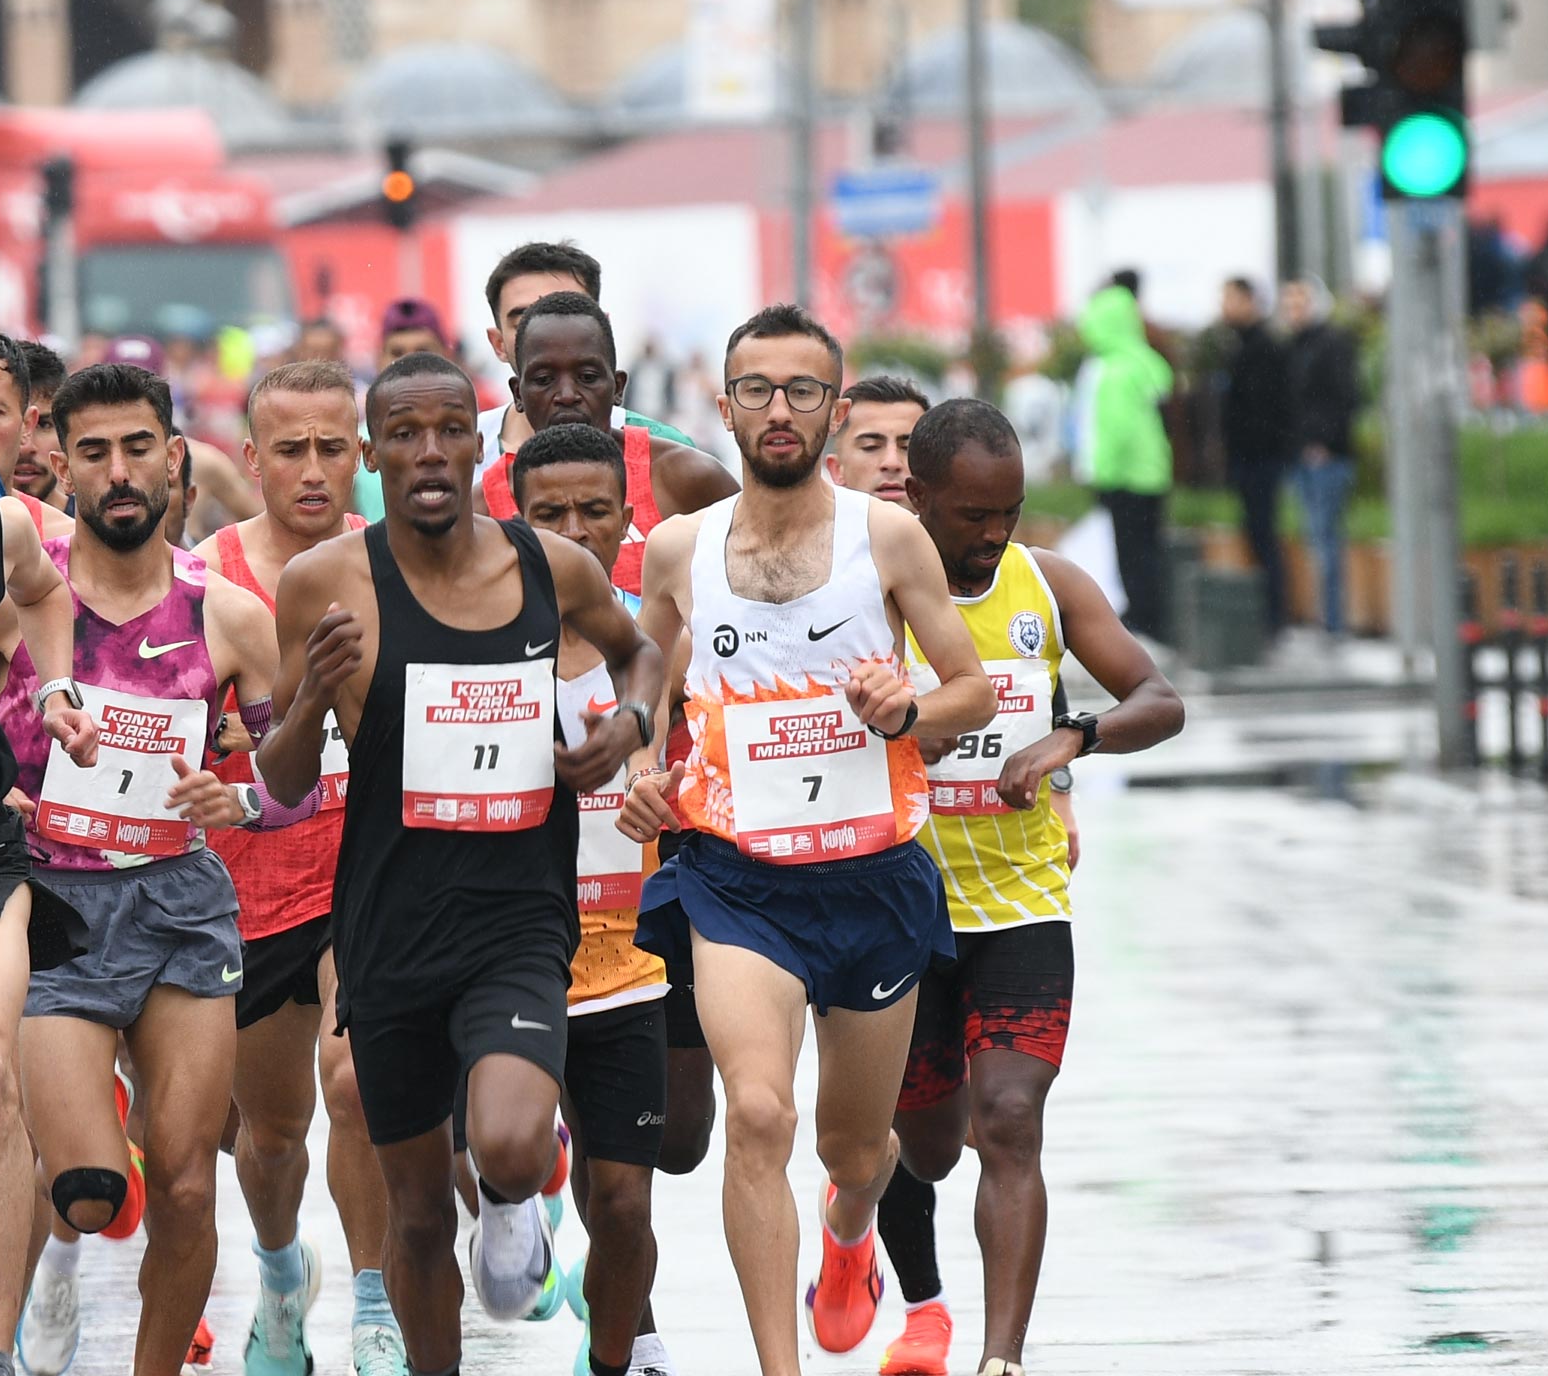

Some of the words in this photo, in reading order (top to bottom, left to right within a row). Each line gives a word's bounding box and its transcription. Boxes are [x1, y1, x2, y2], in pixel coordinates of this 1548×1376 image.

[745, 630, 768, 643] NN
[457, 681, 518, 697] KONYA
[467, 696, 509, 709] YARI
[107, 709, 168, 729] KONYA
[433, 703, 536, 722] MARATONU
[775, 713, 838, 731] KONYA
[116, 722, 158, 739] YARI
[785, 727, 829, 742] YARI
[98, 730, 180, 751] ARATONU
[755, 733, 860, 758] MARATONU
[473, 743, 500, 770] 11
[117, 769, 134, 795] 1
[802, 774, 823, 802] 7
